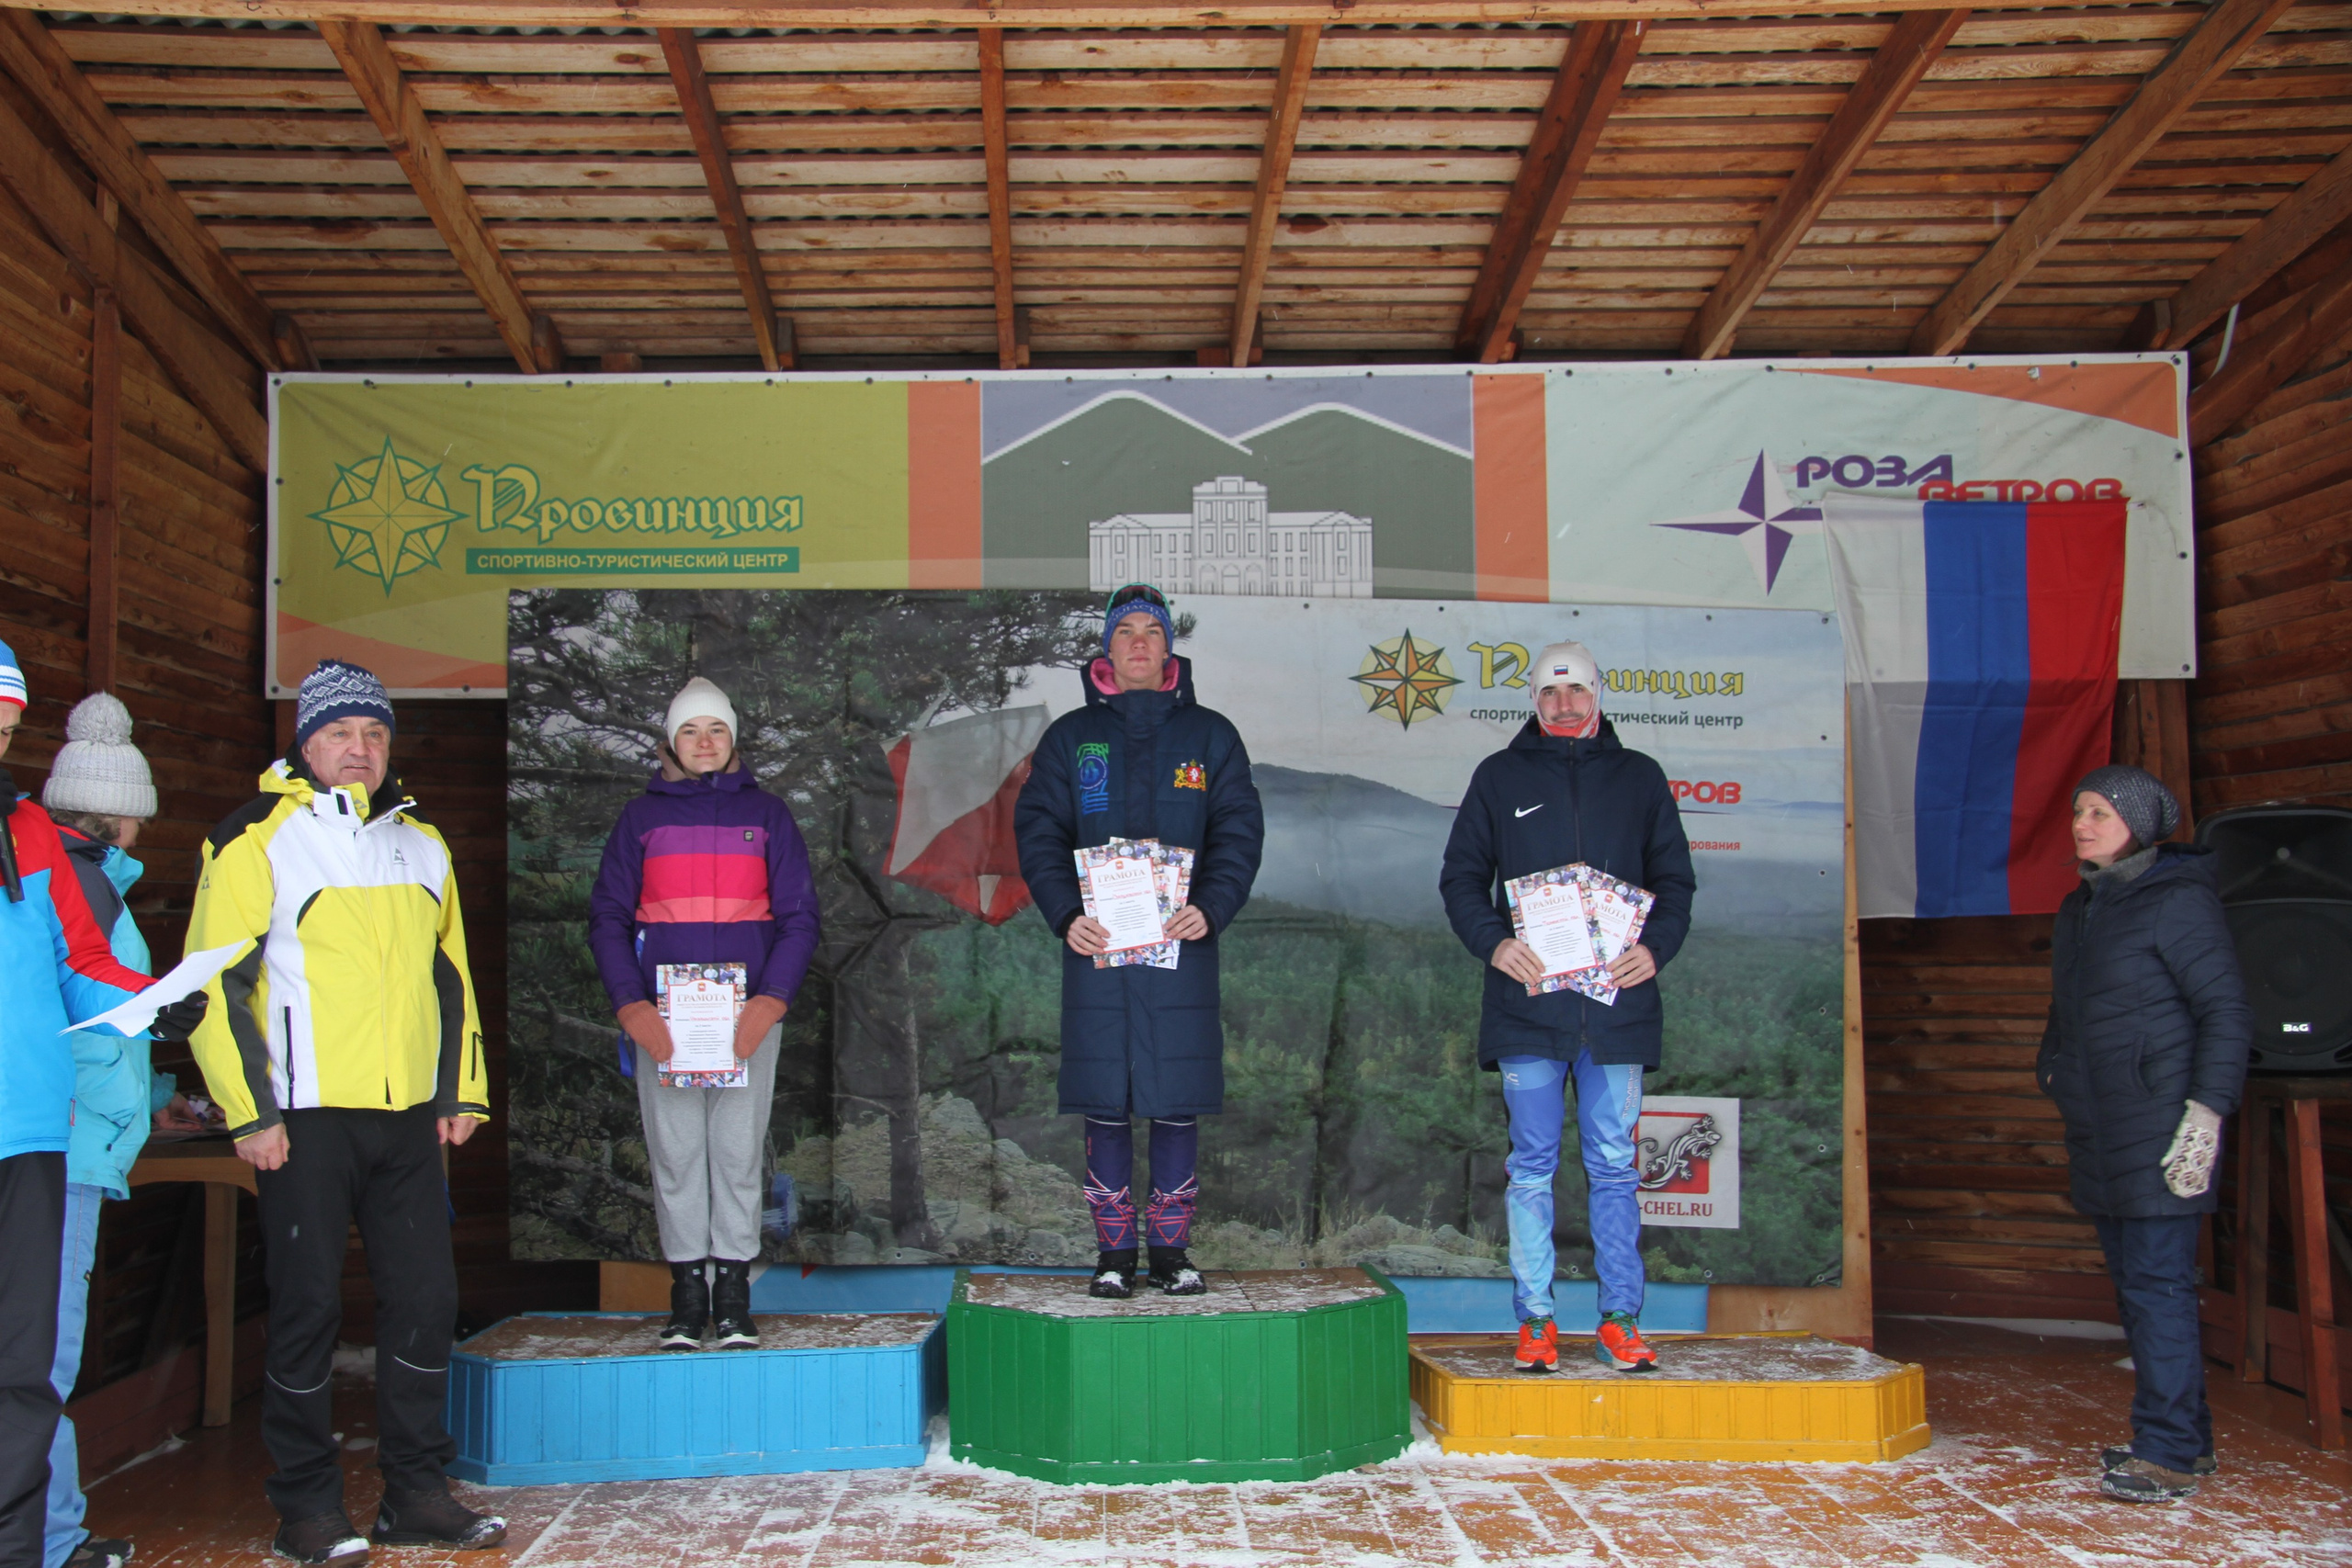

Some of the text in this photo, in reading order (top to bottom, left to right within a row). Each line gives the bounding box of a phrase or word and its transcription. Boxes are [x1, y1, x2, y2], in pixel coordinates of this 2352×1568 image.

[1796, 455, 1953, 488] РОЗА
[460, 463, 803, 546] Провинция
[477, 552, 788, 569] СПОРТИВНО-ТУРИСТИЧЕСКИЙ ЦЕНТР
[1466, 641, 1743, 699] Пинция
[1694, 715, 1744, 729] центр
[1668, 780, 1741, 804] РОВ
[1689, 840, 1741, 852] рования
[1097, 869, 1147, 883] ГРАМОТА
[1527, 895, 1574, 911] ГРАМОТА
[677, 994, 727, 1002] ГРАМОТА
[2282, 1023, 2310, 1032] B&G
[1639, 1201, 1713, 1217] -CHEL.RU
